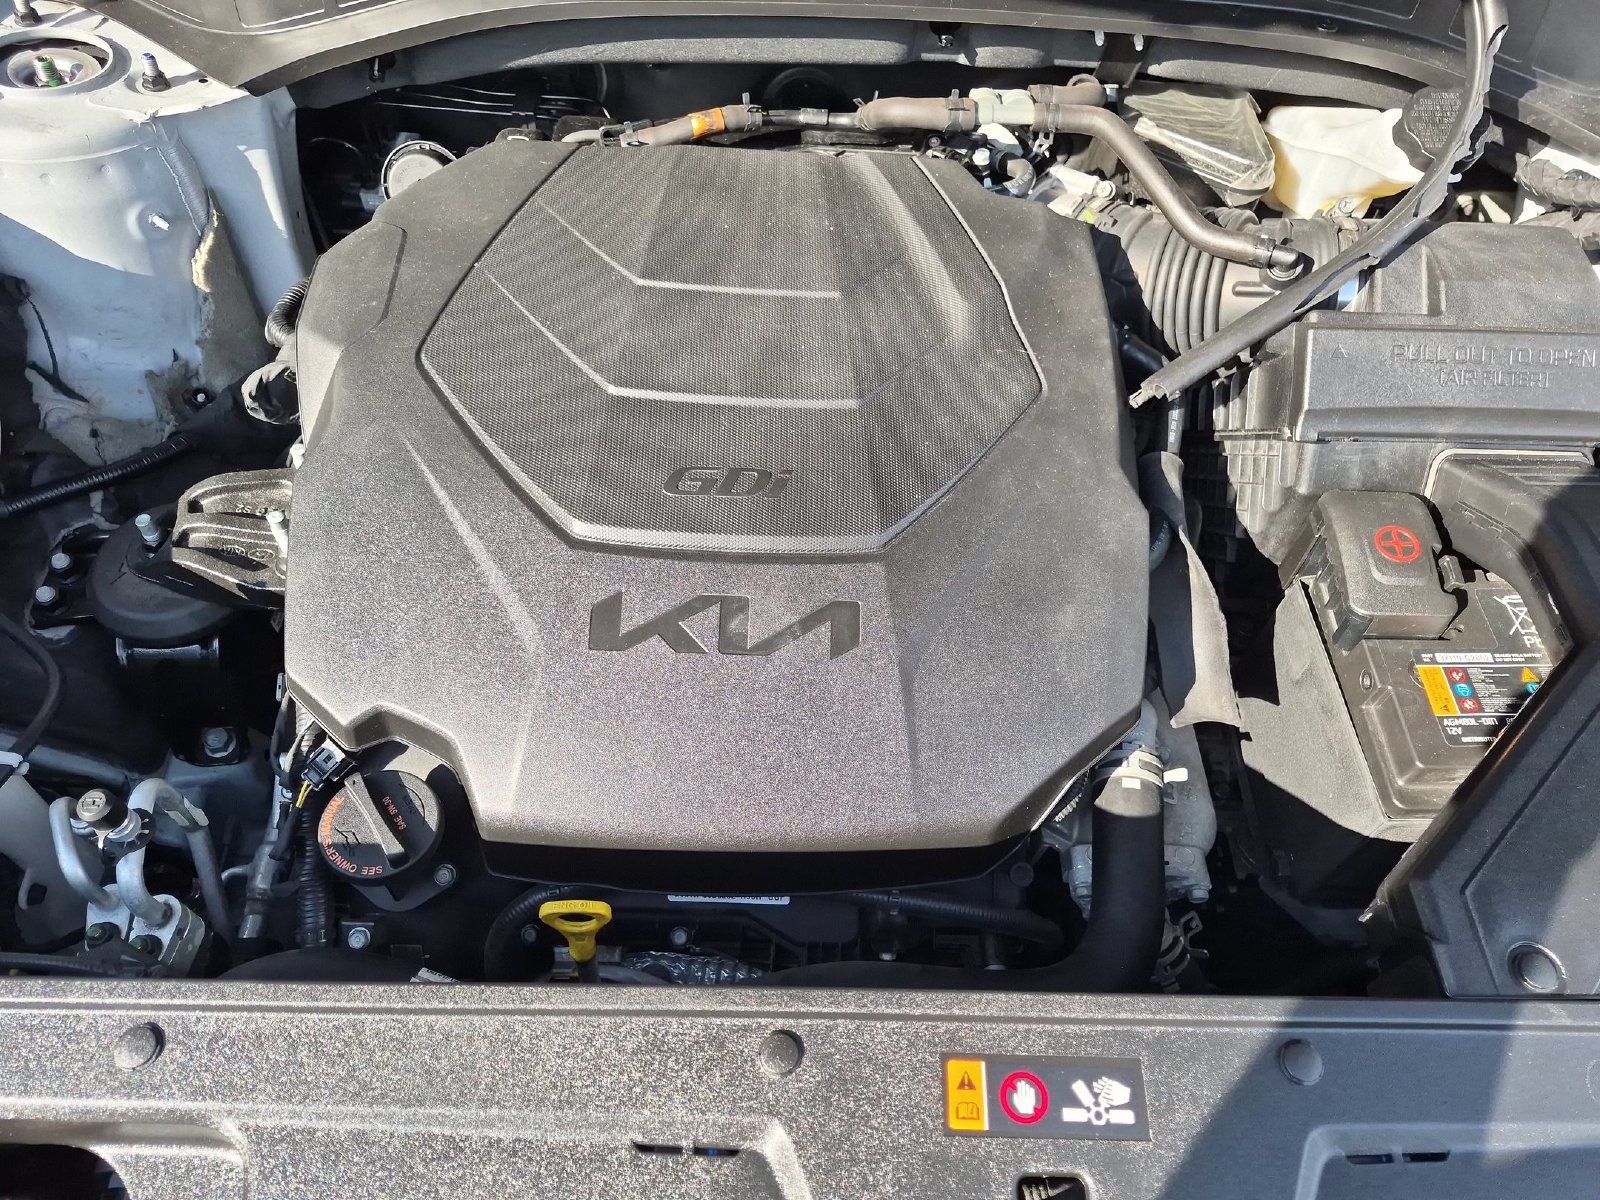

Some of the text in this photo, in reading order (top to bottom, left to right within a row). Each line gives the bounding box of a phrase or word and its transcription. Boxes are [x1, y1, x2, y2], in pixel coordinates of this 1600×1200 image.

[1392, 345, 1596, 368] PULL OUT TO OPEN
[662, 466, 794, 498] GDi
[588, 590, 862, 660] KIA
[1446, 727, 1462, 735] 12V
[382, 796, 407, 831] SAE 5W-30
[323, 839, 357, 873] OWNER'S
[361, 866, 383, 875] SEE
[553, 901, 576, 910] ENG
